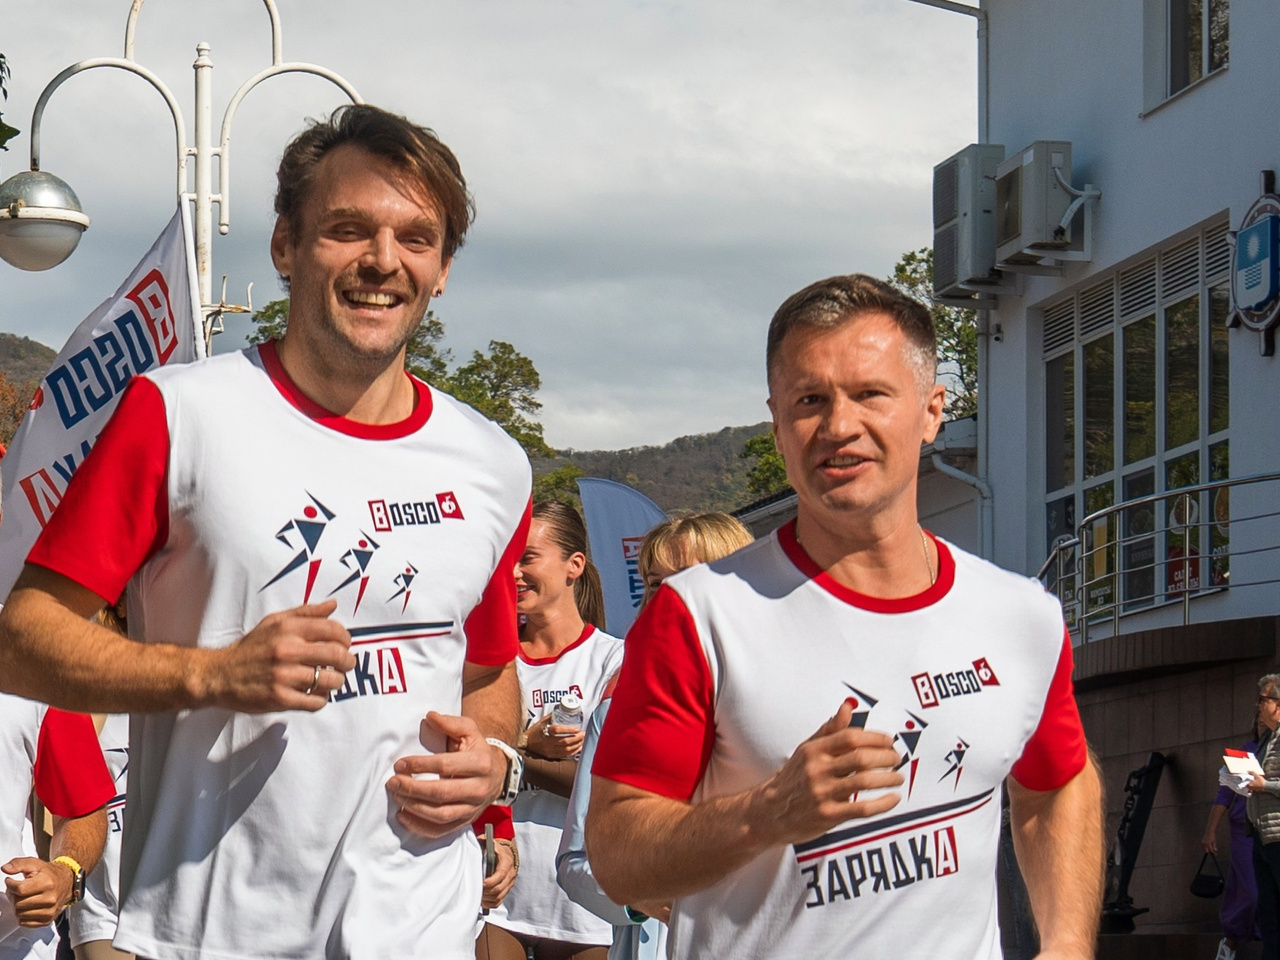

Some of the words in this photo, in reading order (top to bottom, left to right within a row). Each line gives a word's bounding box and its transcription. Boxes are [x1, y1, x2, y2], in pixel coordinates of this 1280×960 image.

[368, 498, 441, 533] BOSCO
[910, 669, 982, 709] BOSCO
[801, 825, 959, 909] ЗАРЯДКА
